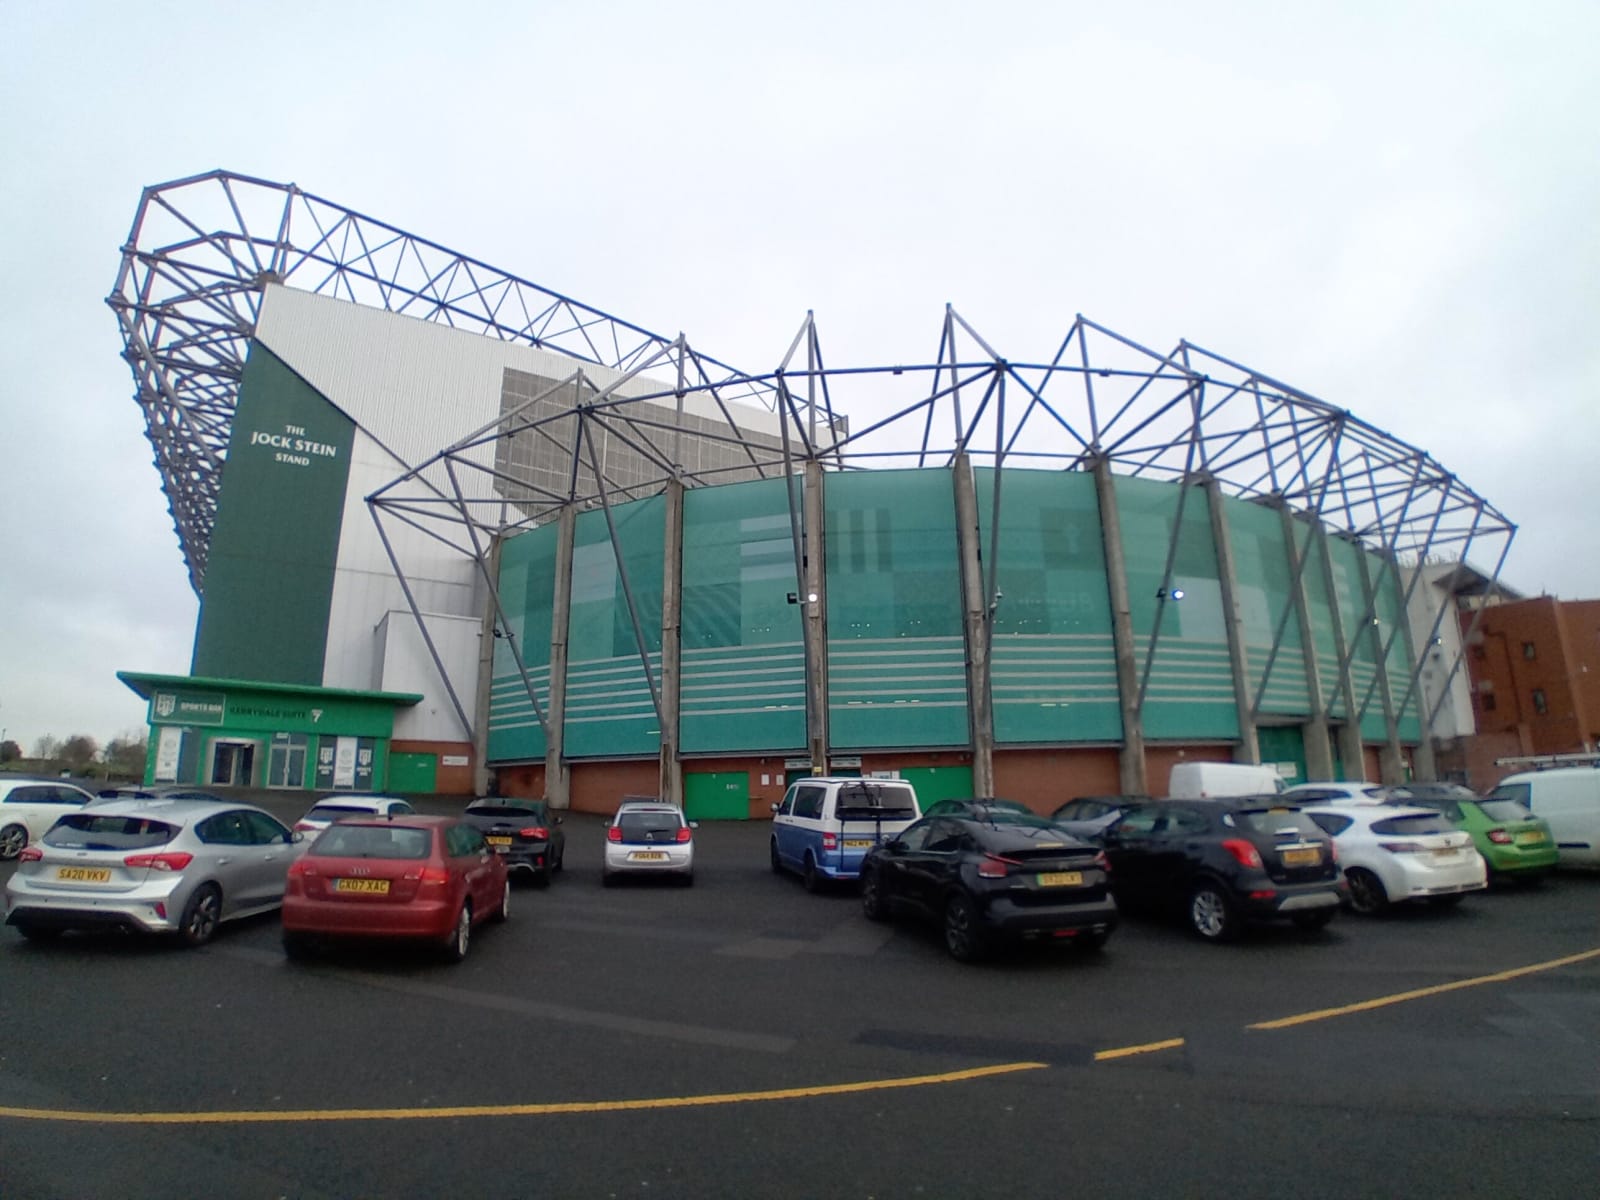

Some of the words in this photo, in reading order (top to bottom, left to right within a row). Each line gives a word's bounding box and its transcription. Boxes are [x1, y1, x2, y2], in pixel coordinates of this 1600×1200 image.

[285, 424, 305, 436] THE
[250, 431, 292, 450] JOCK
[294, 439, 337, 458] STEIN
[275, 452, 311, 467] STAND
[311, 708, 324, 723] 7
